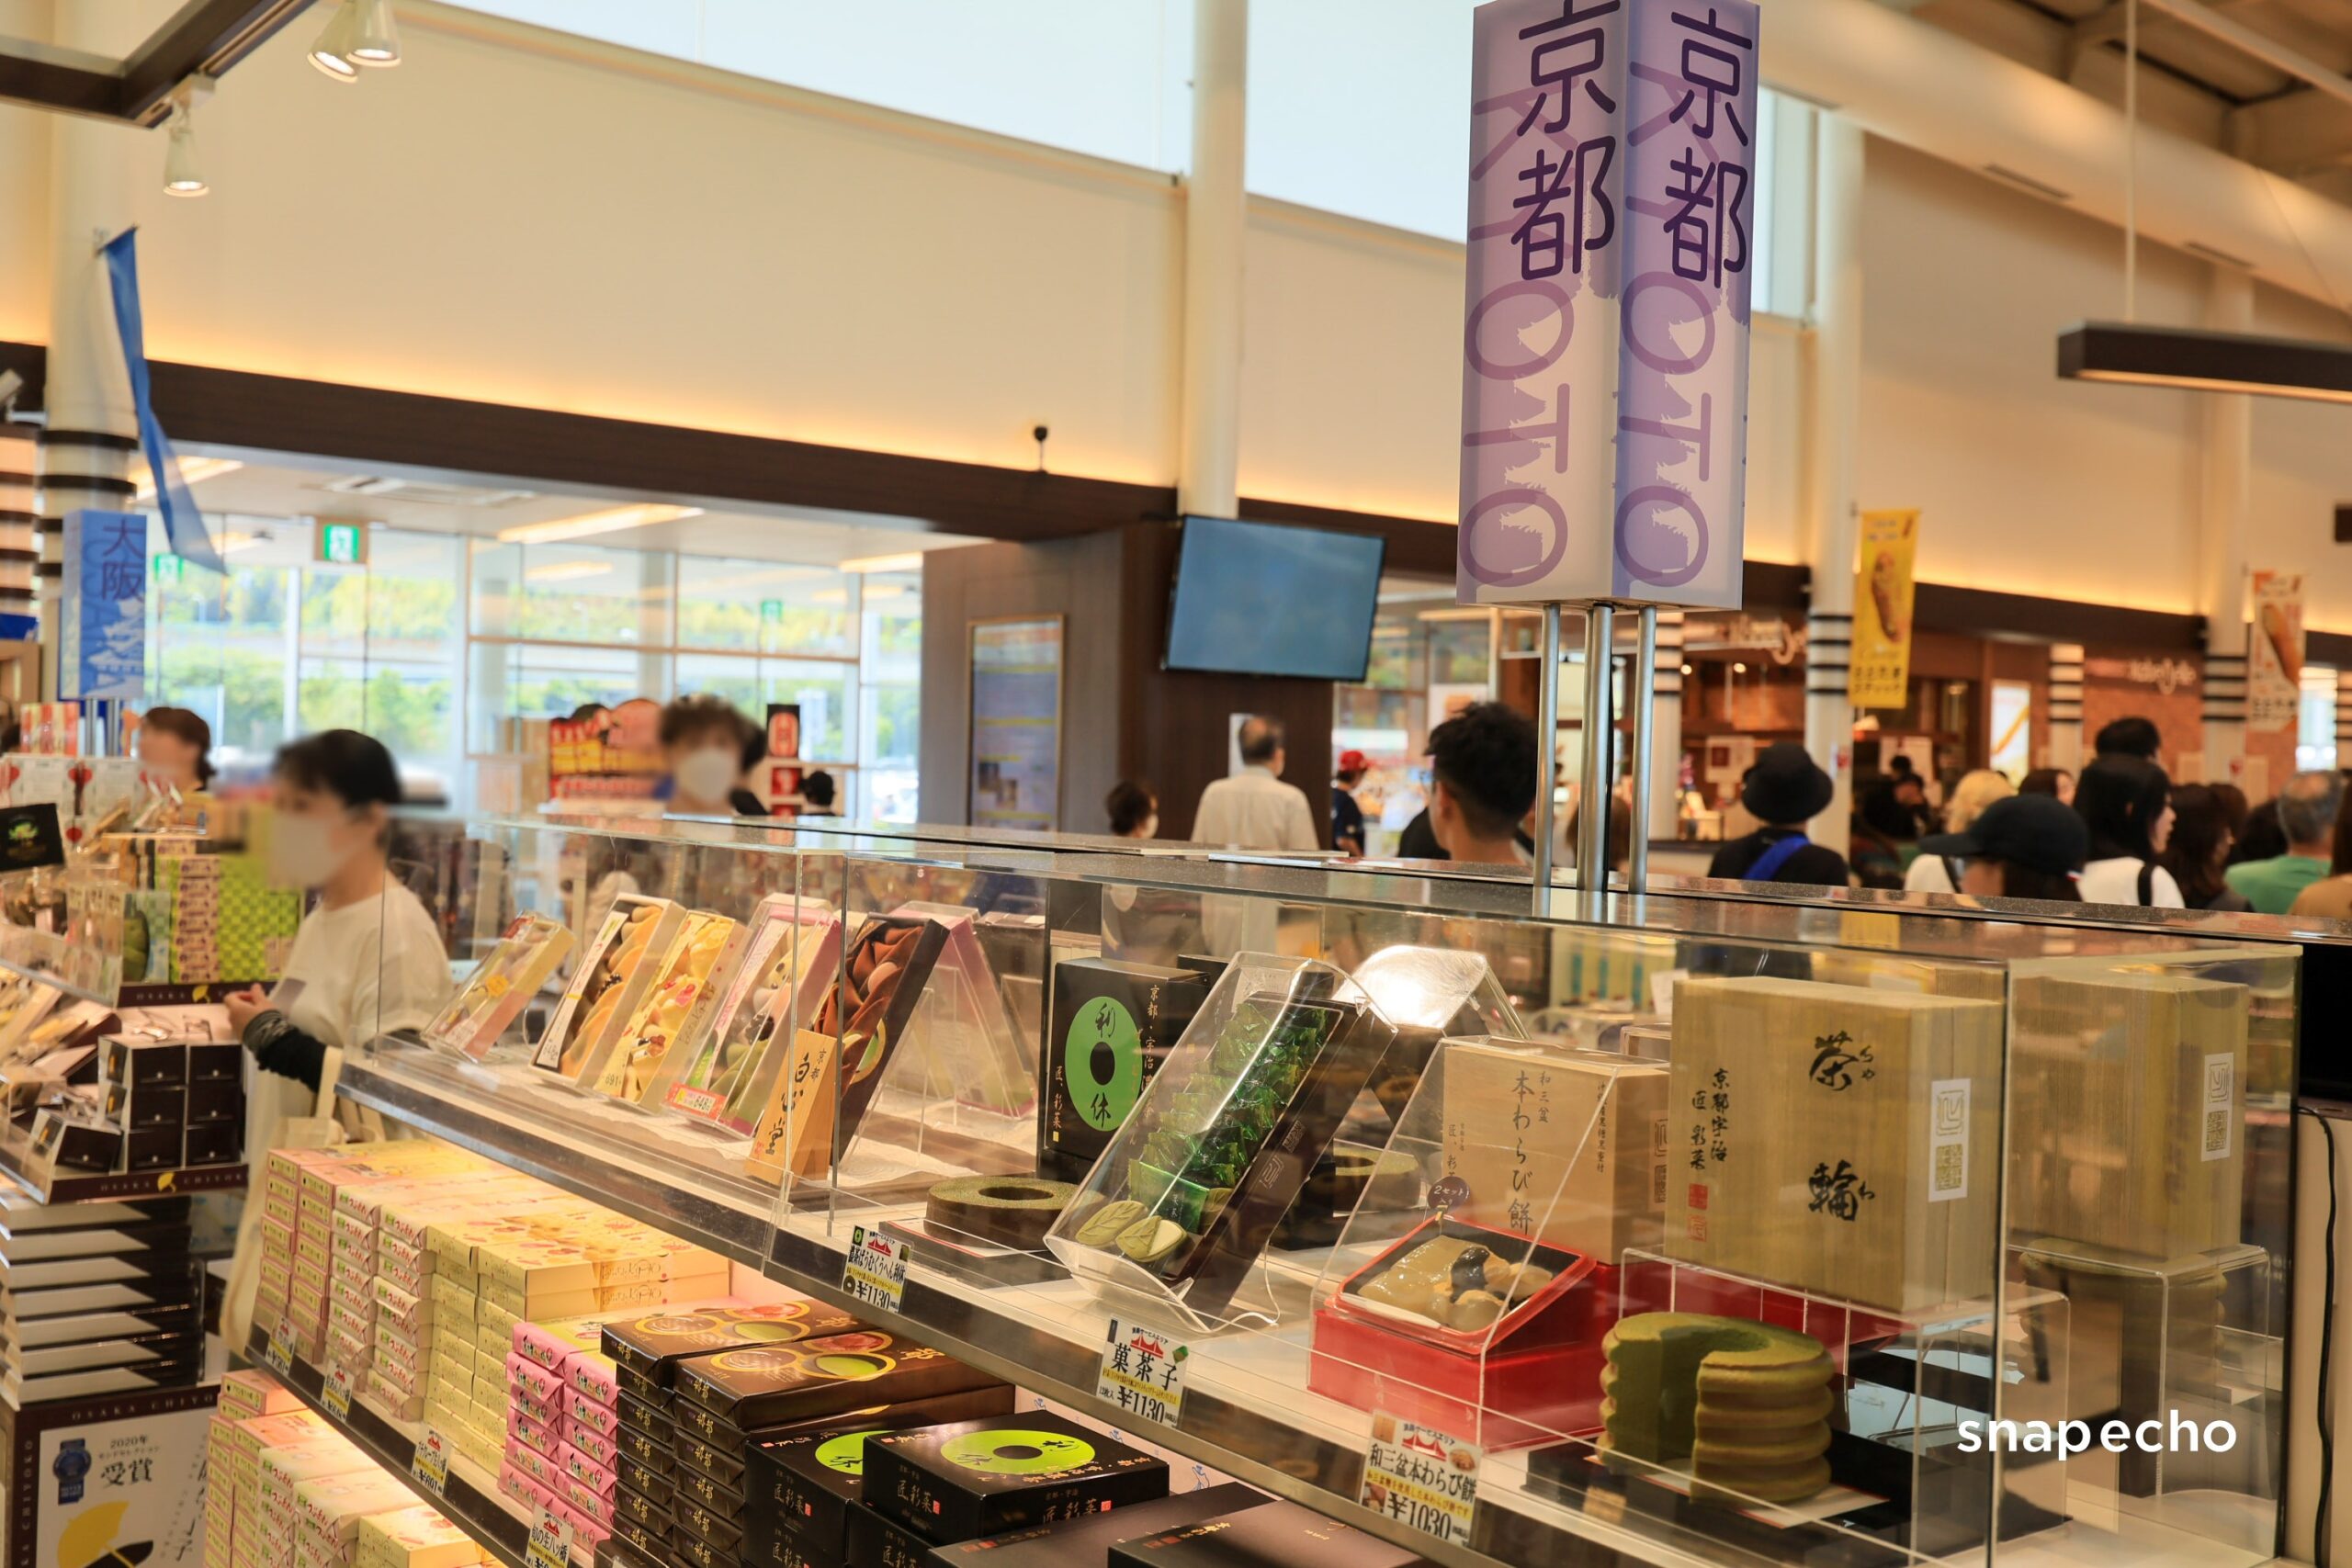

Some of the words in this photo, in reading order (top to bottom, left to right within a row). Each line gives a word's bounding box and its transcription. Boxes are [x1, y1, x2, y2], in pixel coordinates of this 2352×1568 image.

[1510, 0, 1622, 281] 京都
[1662, 7, 1753, 289] 京都
[101, 518, 145, 604] 大阪
[1090, 1002, 1116, 1129] 利休
[1538, 1071, 1551, 1123] 和三盆
[1711, 1067, 1730, 1162] 京都宇治
[1508, 1070, 1534, 1235] 本わらび餅
[856, 1280, 890, 1310] ¥1130
[1111, 1342, 1178, 1392] 菓茶子
[1116, 1385, 1165, 1424] ¥1130
[109, 1435, 148, 1450] 2020年
[101, 1457, 153, 1488] 受賞
[1370, 1443, 1477, 1504] 和三盆本わらび餅
[1387, 1491, 1451, 1540] ¥1030
